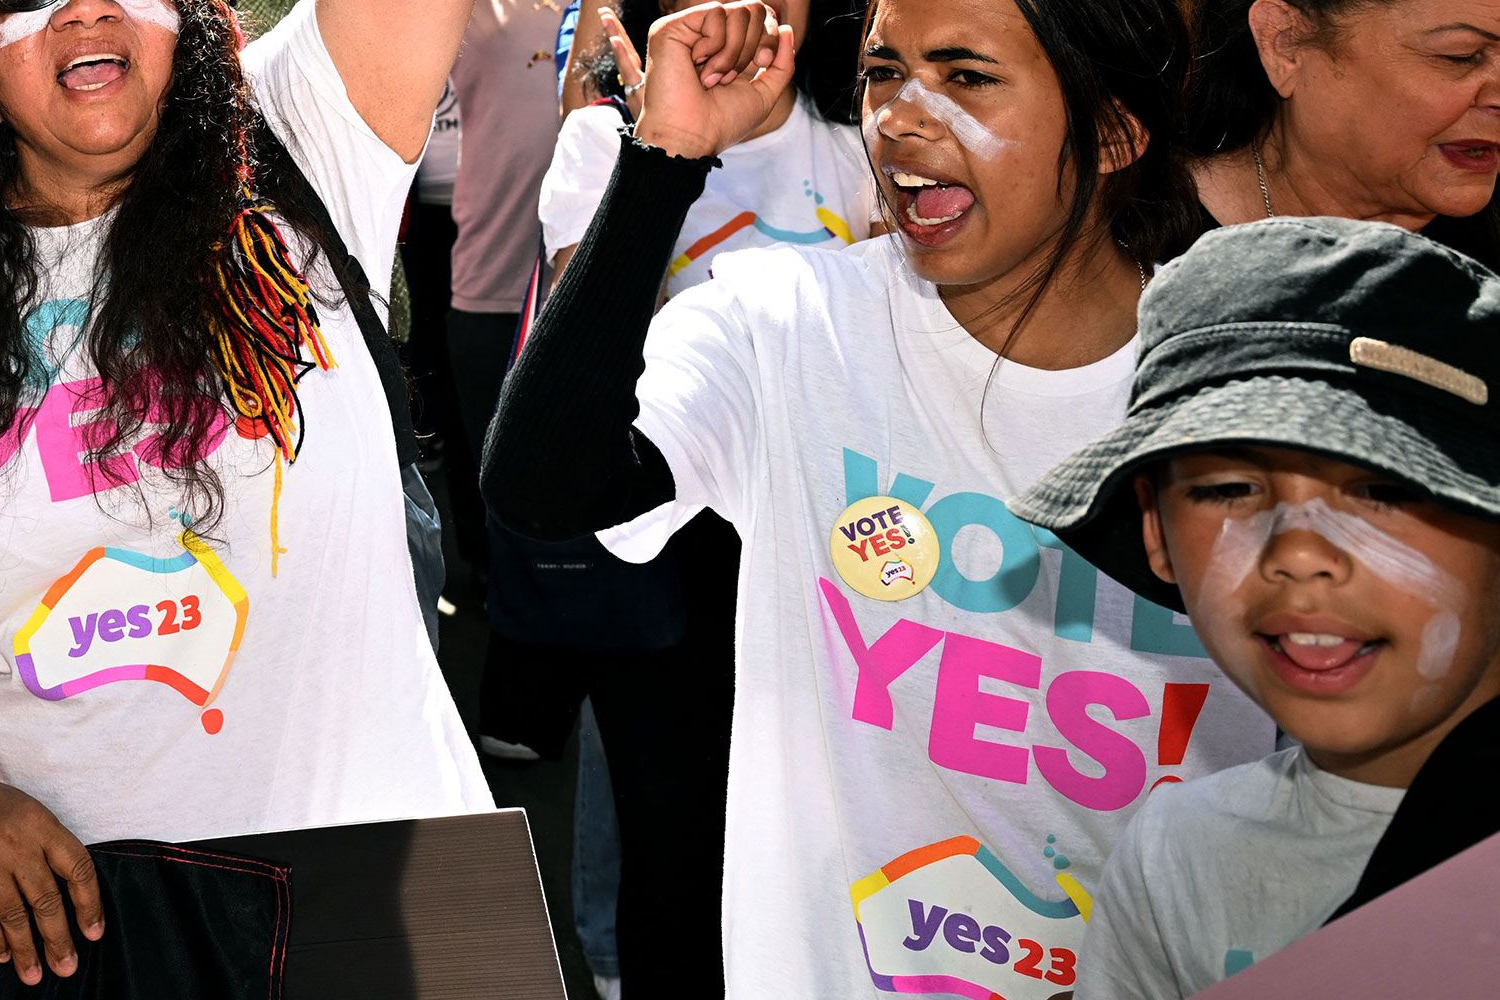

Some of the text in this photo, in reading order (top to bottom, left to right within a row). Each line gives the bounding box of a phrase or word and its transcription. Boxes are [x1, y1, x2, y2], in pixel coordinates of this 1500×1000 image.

[839, 505, 903, 542] VOTE
[847, 524, 915, 562] YES!
[819, 576, 1210, 812] YES!
